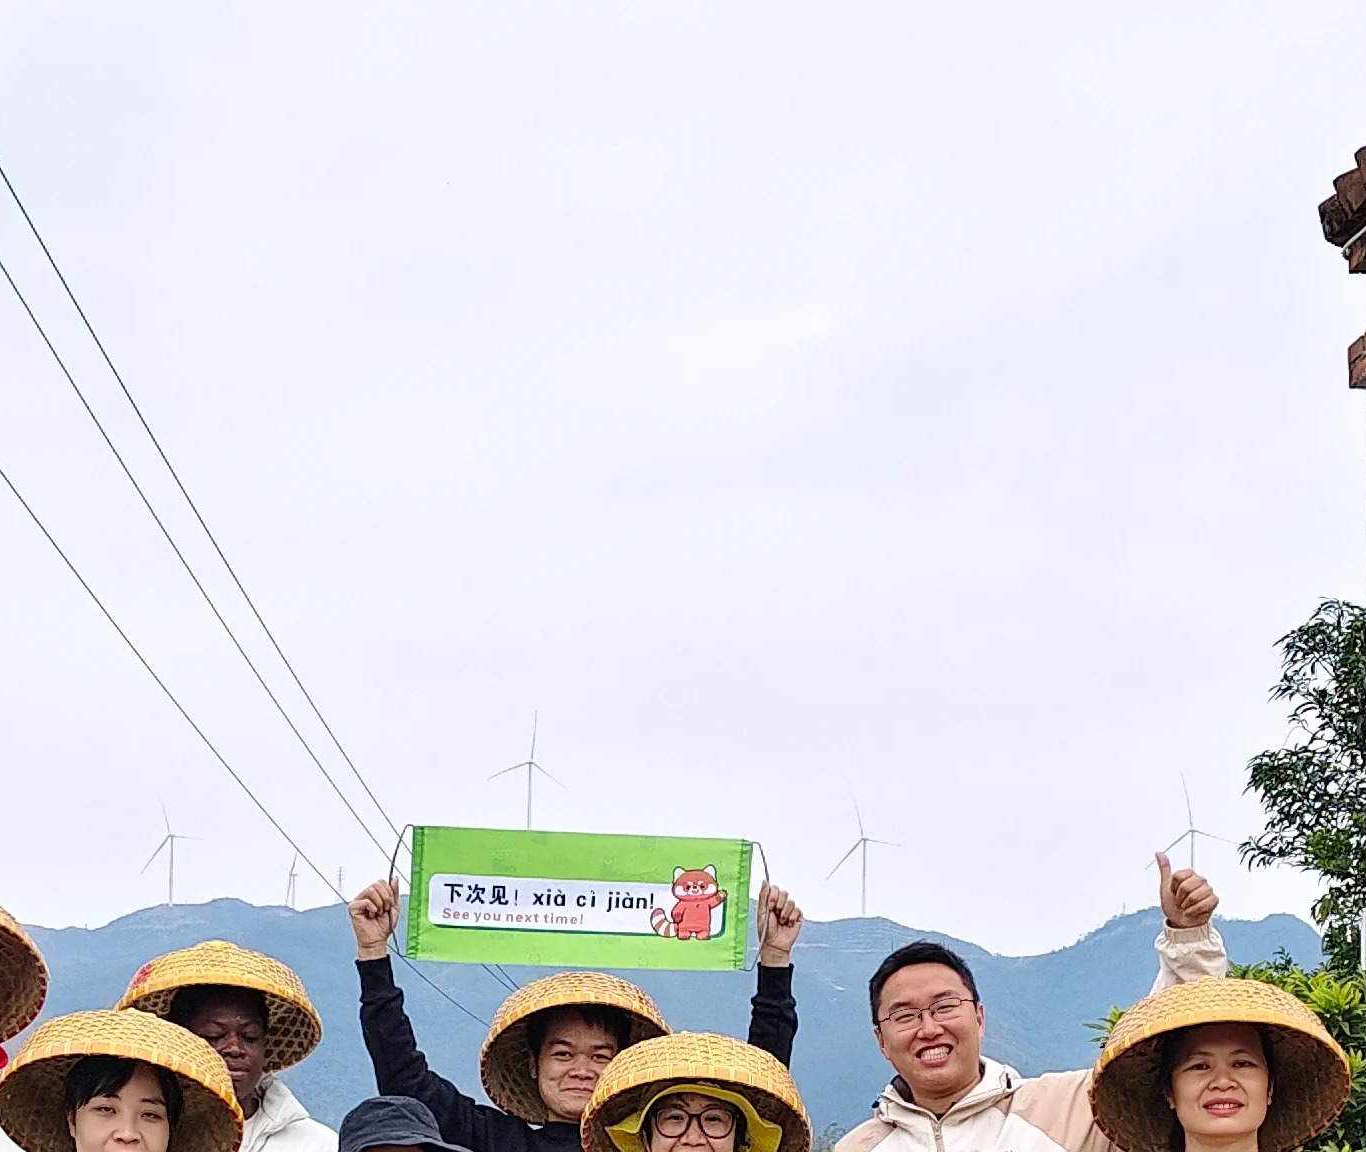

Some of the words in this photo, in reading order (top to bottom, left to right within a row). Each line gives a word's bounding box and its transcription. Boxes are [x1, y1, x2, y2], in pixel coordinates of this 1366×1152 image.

[532, 891, 566, 908] xià
[576, 890, 597, 909] cì
[606, 890, 655, 913] jiàn!
[442, 908, 470, 921] See
[473, 910, 502, 924] you
[506, 912, 540, 924] next
[544, 912, 584, 925] time!
